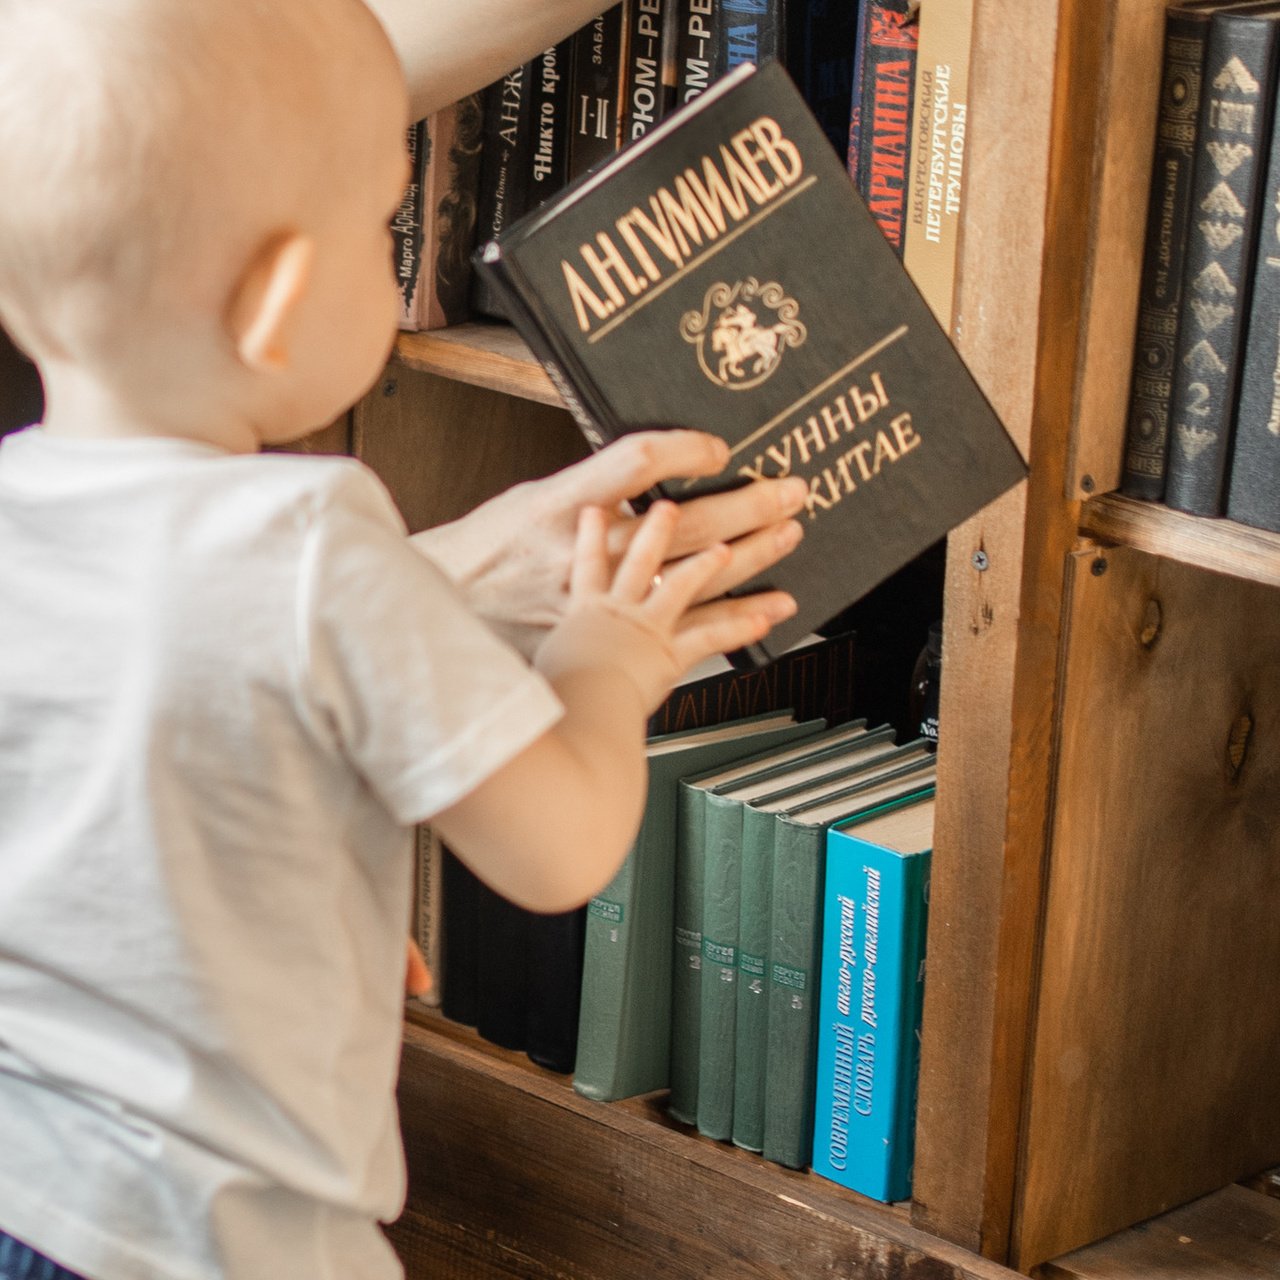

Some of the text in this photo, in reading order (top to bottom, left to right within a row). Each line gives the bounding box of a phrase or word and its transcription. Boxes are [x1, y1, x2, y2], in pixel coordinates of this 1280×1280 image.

[498, 64, 524, 147] АНЖ
[533, 101, 555, 182] Никто
[925, 63, 951, 243] ПЕТЕРБУРГСКИЕ
[391, 183, 420, 235] Арнольд
[495, 166, 507, 200] Голон
[492, 201, 504, 232] Серж
[1159, 159, 1179, 269] ДОСТОЕВСКИЙ
[399, 237, 415, 279] Марго
[1184, 381, 1211, 417] 2
[738, 371, 890, 484] ХУННЫ
[805, 412, 921, 519] КИТАЕ
[610, 928, 618, 942] 1
[689, 955, 701, 970] 2
[720, 968, 733, 982] 3
[748, 979, 763, 994] 4
[853, 865, 881, 1117] СЛОВАРЬ русско-английский
[828, 894, 855, 1172] СОВРЕМЕННЫЙ англо-русский
